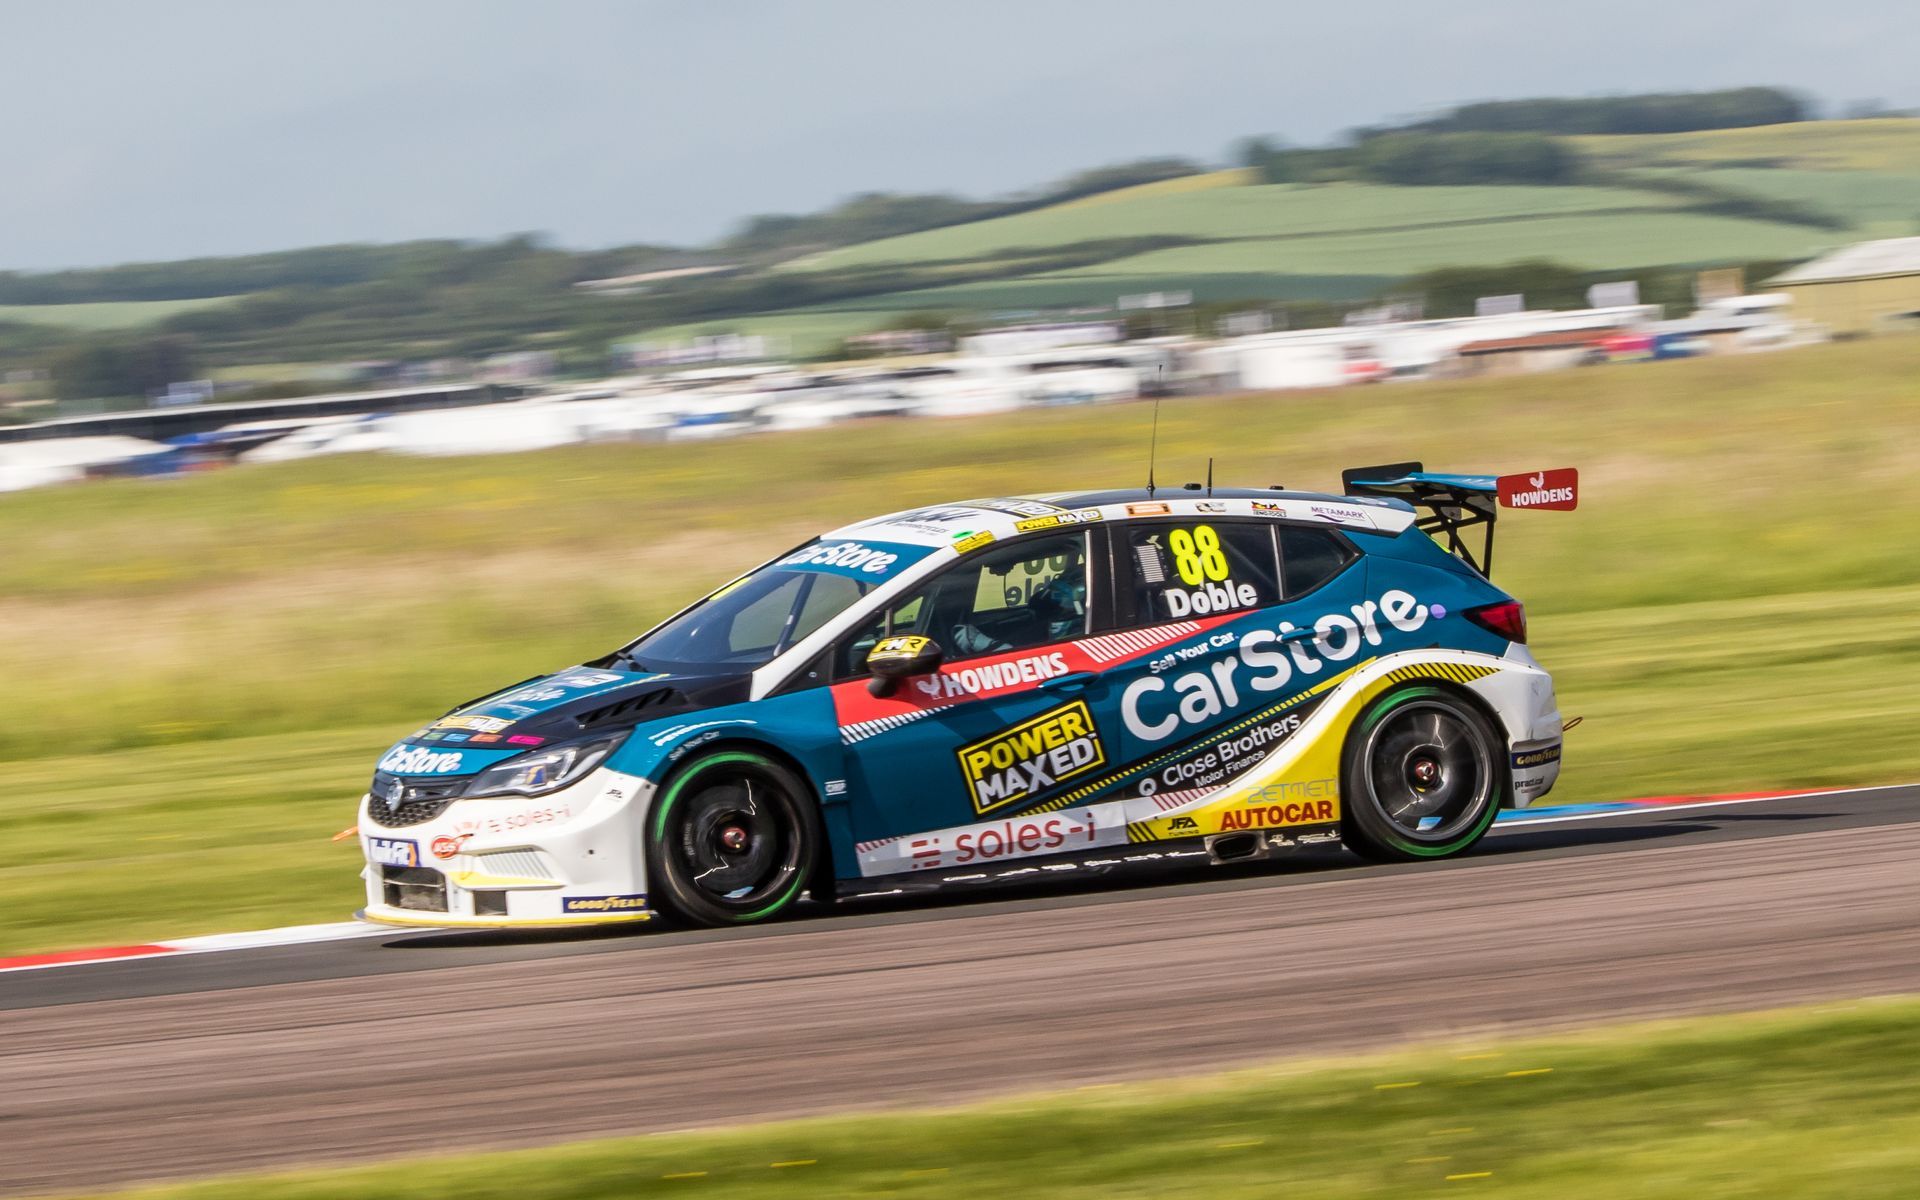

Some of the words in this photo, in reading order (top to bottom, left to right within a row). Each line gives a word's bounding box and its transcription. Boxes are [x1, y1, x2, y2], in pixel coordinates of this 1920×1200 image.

[1311, 506, 1364, 519] METAMARK
[1512, 487, 1573, 507] HOWDENS
[1018, 515, 1059, 529] POWER
[1169, 525, 1229, 586] 88
[1165, 580, 1258, 618] Doble
[943, 652, 1069, 698] HOWDENS
[1149, 654, 1176, 673] Sell
[1175, 642, 1209, 660] Your
[967, 711, 1088, 780] POWER
[1163, 753, 1217, 786] Close
[1218, 714, 1301, 762] Brothers
[975, 737, 1095, 806] MAXED
[1195, 769, 1224, 788] Motor
[1226, 750, 1266, 774] Finance
[1167, 816, 1199, 830] JFA
[1220, 800, 1334, 831] AUTOCAR
[955, 812, 1096, 863] sales-i
